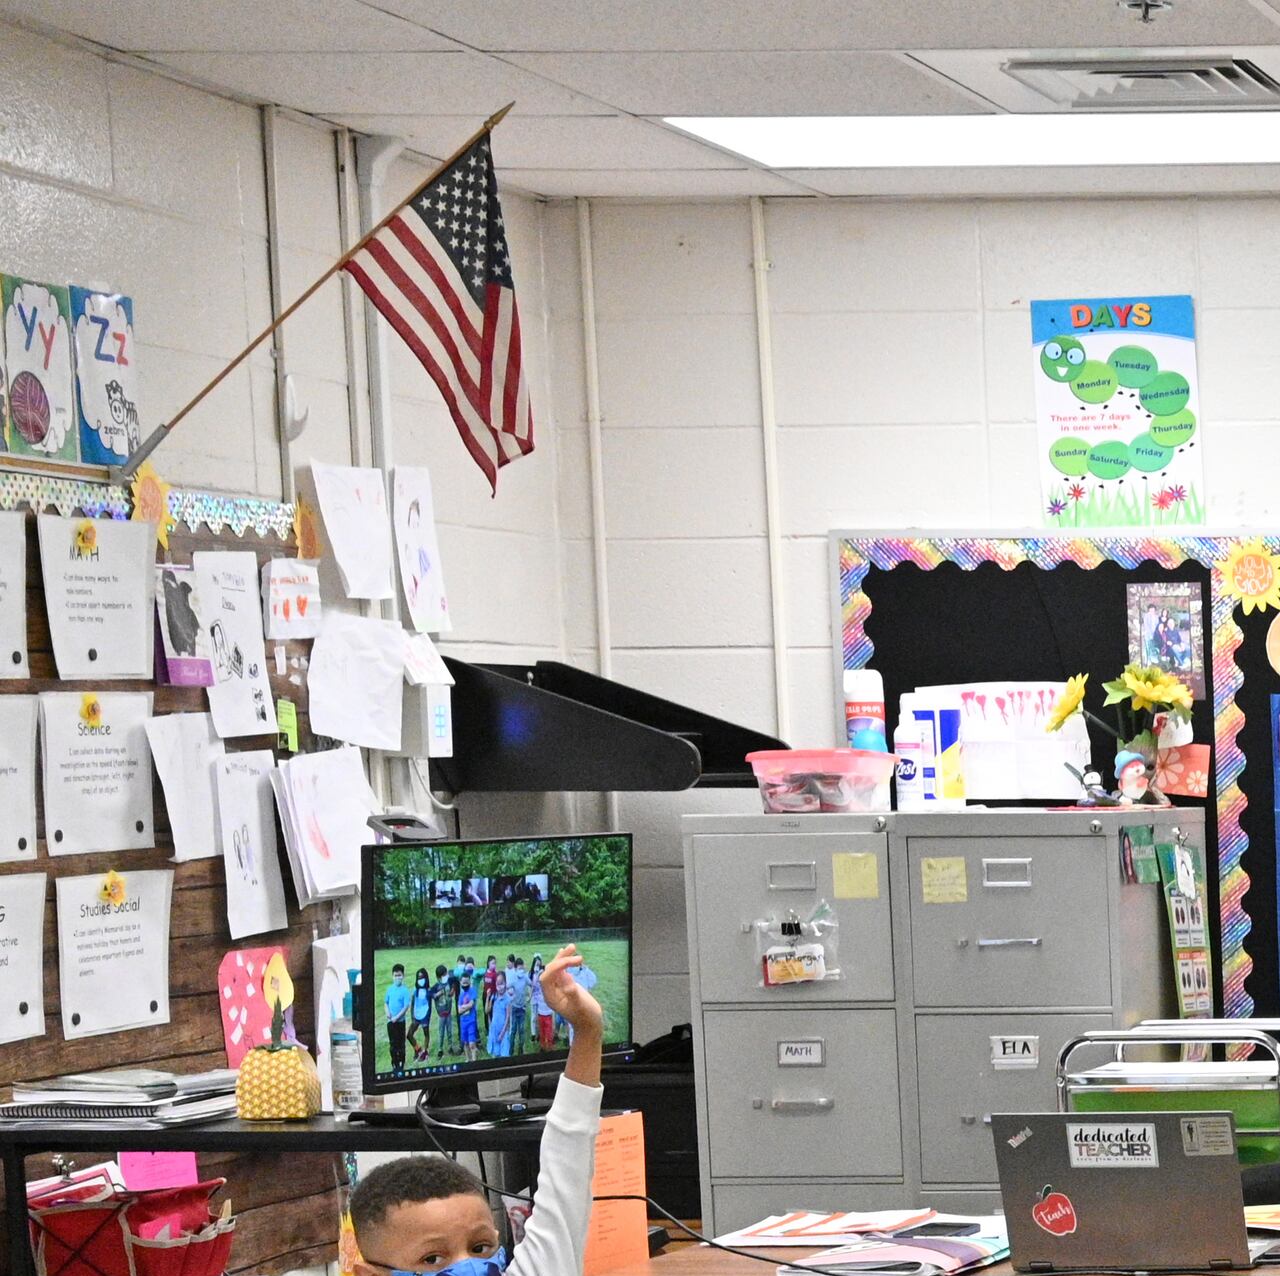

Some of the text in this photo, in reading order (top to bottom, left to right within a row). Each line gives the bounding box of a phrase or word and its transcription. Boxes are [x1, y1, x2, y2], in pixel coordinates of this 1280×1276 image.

[1070, 303, 1152, 328] DAYS
[89, 315, 129, 366] Zz
[1114, 361, 1150, 371] Tuesday
[1077, 378, 1111, 390] Monday
[1141, 387, 1190, 401] Wednesday
[1153, 423, 1193, 433] Thursday
[1055, 449, 1087, 457] Sunday
[1135, 448, 1163, 457] Friday
[1090, 454, 1129, 467] Saturday
[77, 722, 112, 737] Science
[80, 902, 111, 918] Studies
[785, 1044, 813, 1057] MATH
[1002, 1040, 1031, 1055] ELA
[1074, 1128, 1150, 1143] dedicated
[1074, 1143, 1151, 1156] TEACHER
